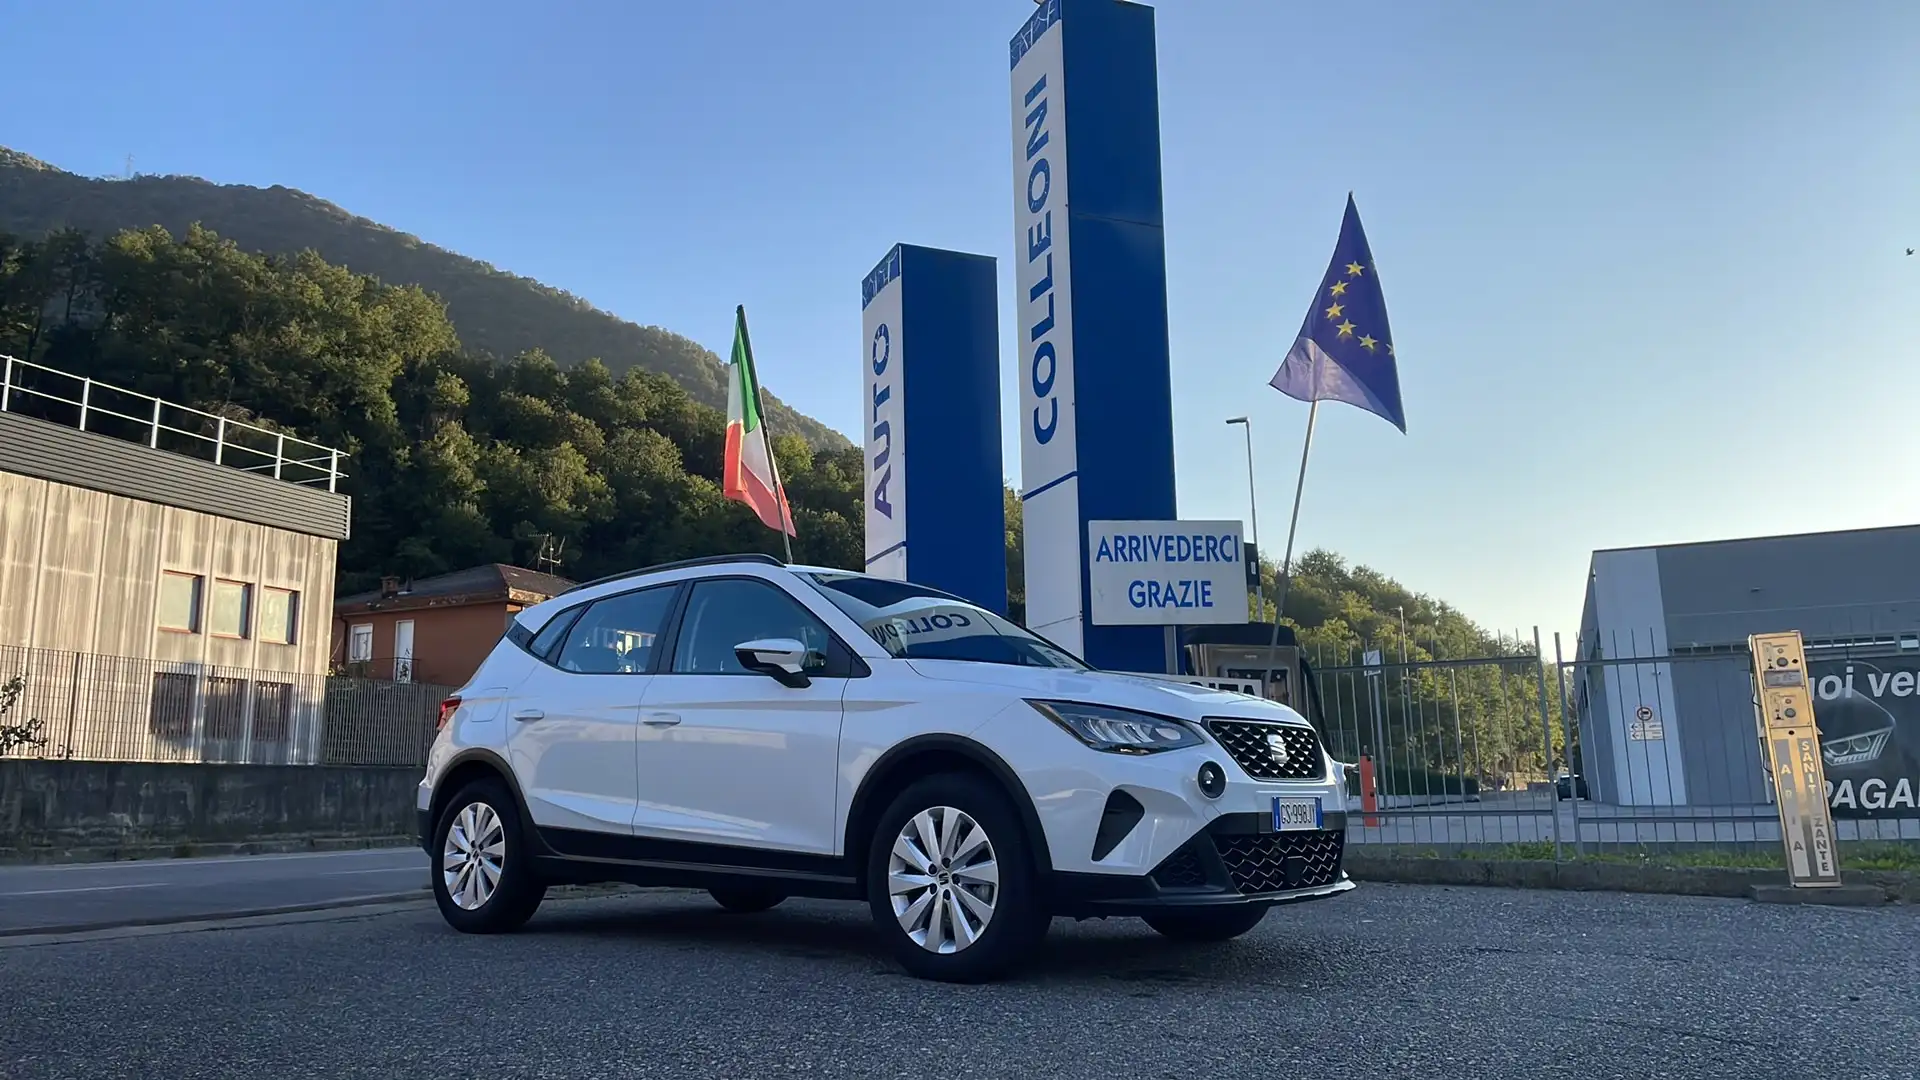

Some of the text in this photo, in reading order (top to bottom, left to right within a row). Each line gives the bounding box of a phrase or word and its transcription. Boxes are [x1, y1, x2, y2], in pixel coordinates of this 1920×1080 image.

[1025, 73, 1058, 445] COLLEONI
[872, 323, 893, 520] AUTO
[1096, 535, 1240, 563] ARRIVEDERCI
[1128, 580, 1213, 608] GRAZIE
[1867, 671, 1920, 698] ve
[1801, 740, 1829, 872] SANITIZANTE
[1825, 778, 1920, 810] AGA
